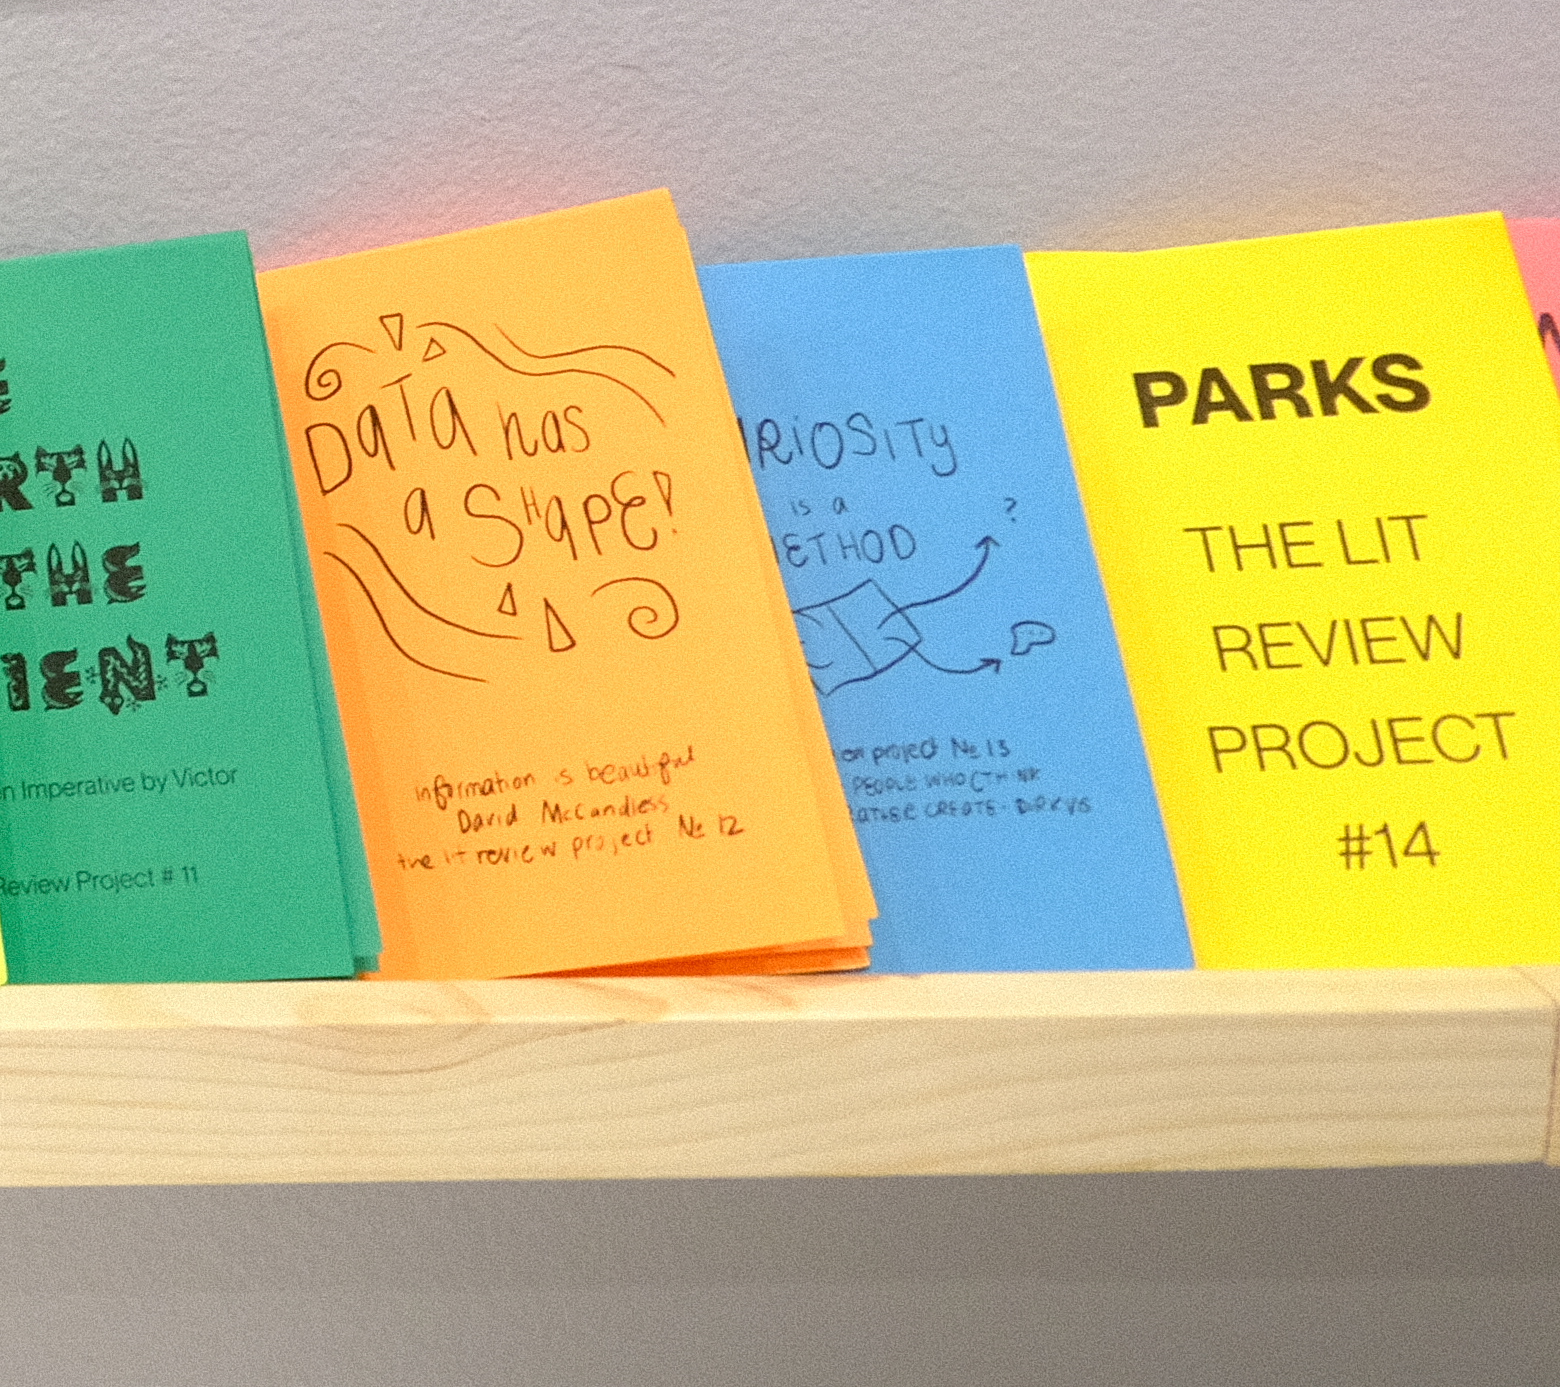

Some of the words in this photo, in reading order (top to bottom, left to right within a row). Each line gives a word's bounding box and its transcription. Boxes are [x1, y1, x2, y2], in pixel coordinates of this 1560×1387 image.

[1132, 352, 1432, 428] PARKS
[1183, 520, 1323, 573] THE
[1336, 513, 1427, 565] LIT
[1213, 612, 1466, 672] REVIEW
[1207, 711, 1516, 773] PROJECT
[20, 773, 136, 799] Imperative
[141, 775, 167, 795] by
[173, 765, 238, 790] Victor
[1338, 821, 1440, 871] #14
